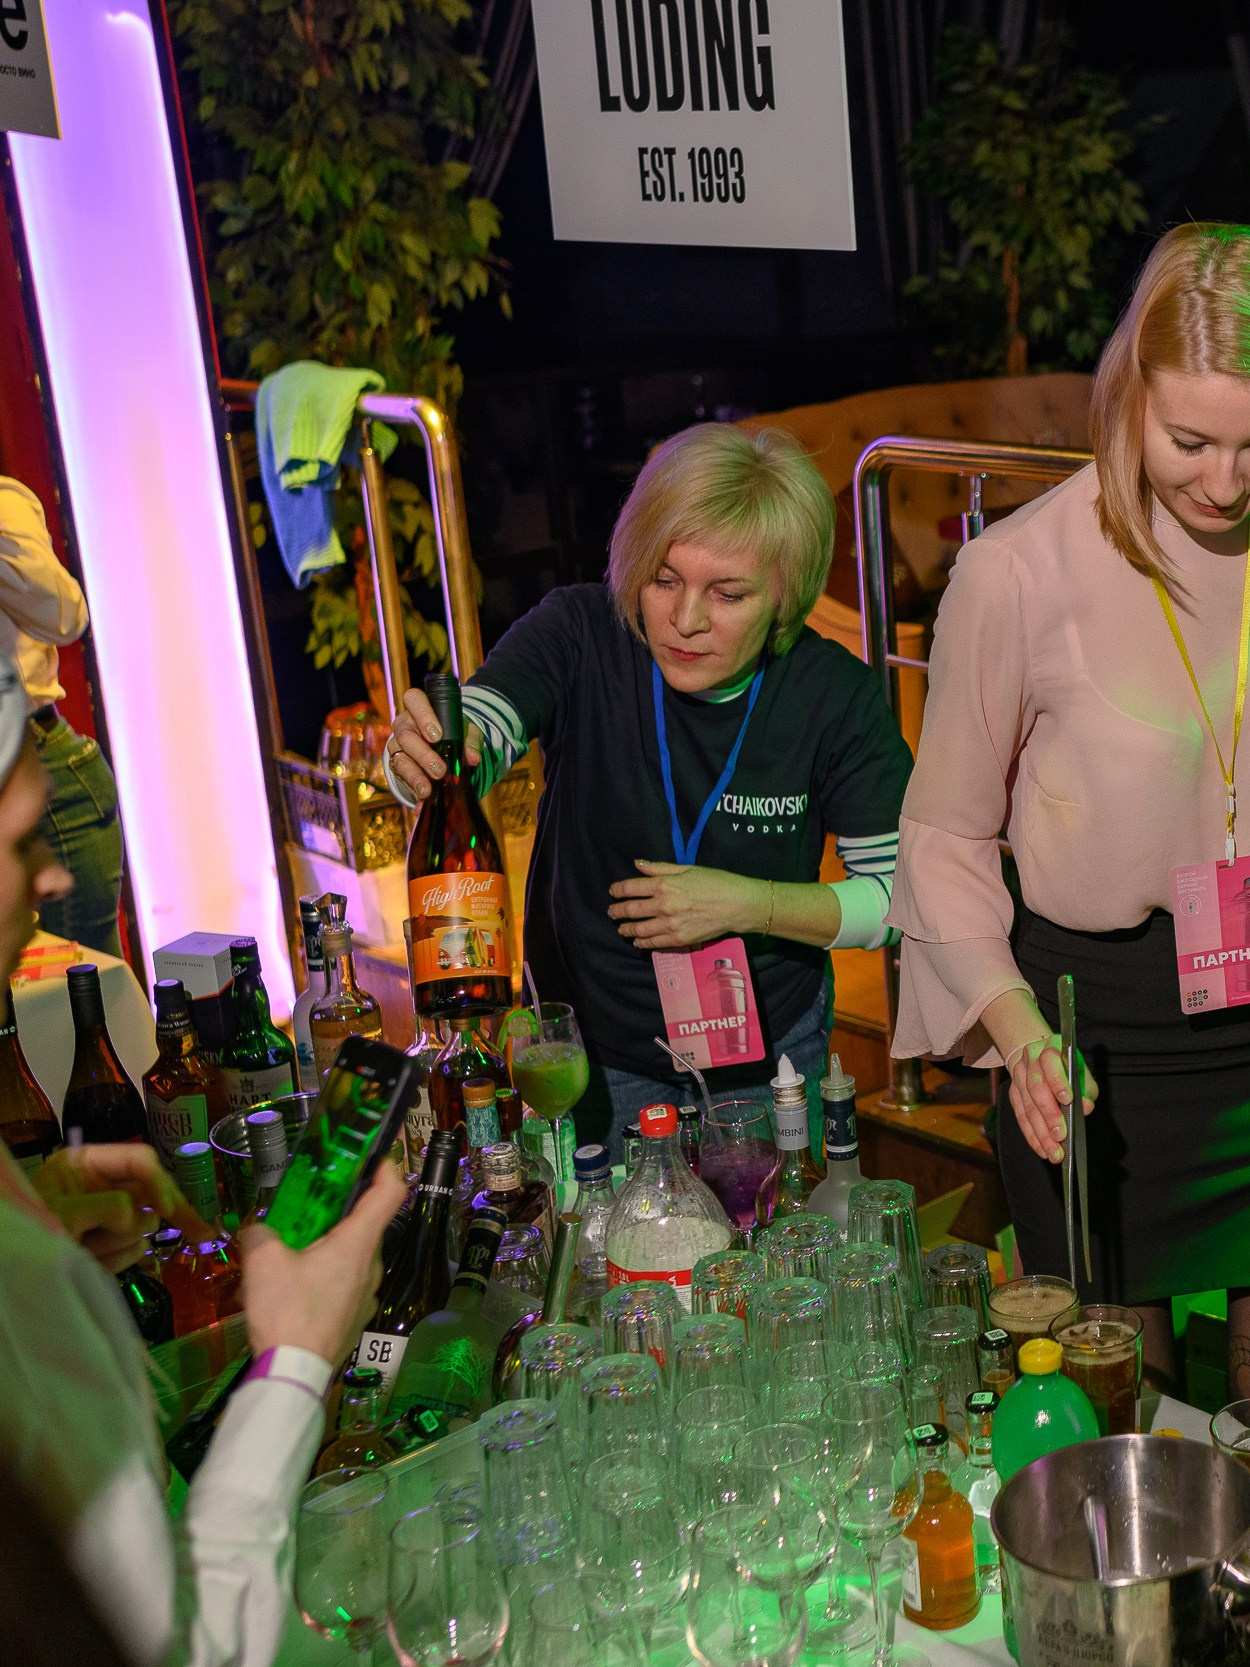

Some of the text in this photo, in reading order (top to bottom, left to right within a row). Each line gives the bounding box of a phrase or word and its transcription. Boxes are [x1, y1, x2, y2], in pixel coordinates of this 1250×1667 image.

[591, 0, 775, 112] LUDING
[638, 147, 746, 203] EST. 1993
[732, 823, 796, 834] VODKA
[421, 884, 458, 915] High
[678, 1015, 748, 1036] ПАРТНЕР
[776, 1126, 805, 1138] MBINI
[423, 1183, 449, 1195] URBAN
[366, 1339, 393, 1364] SB
